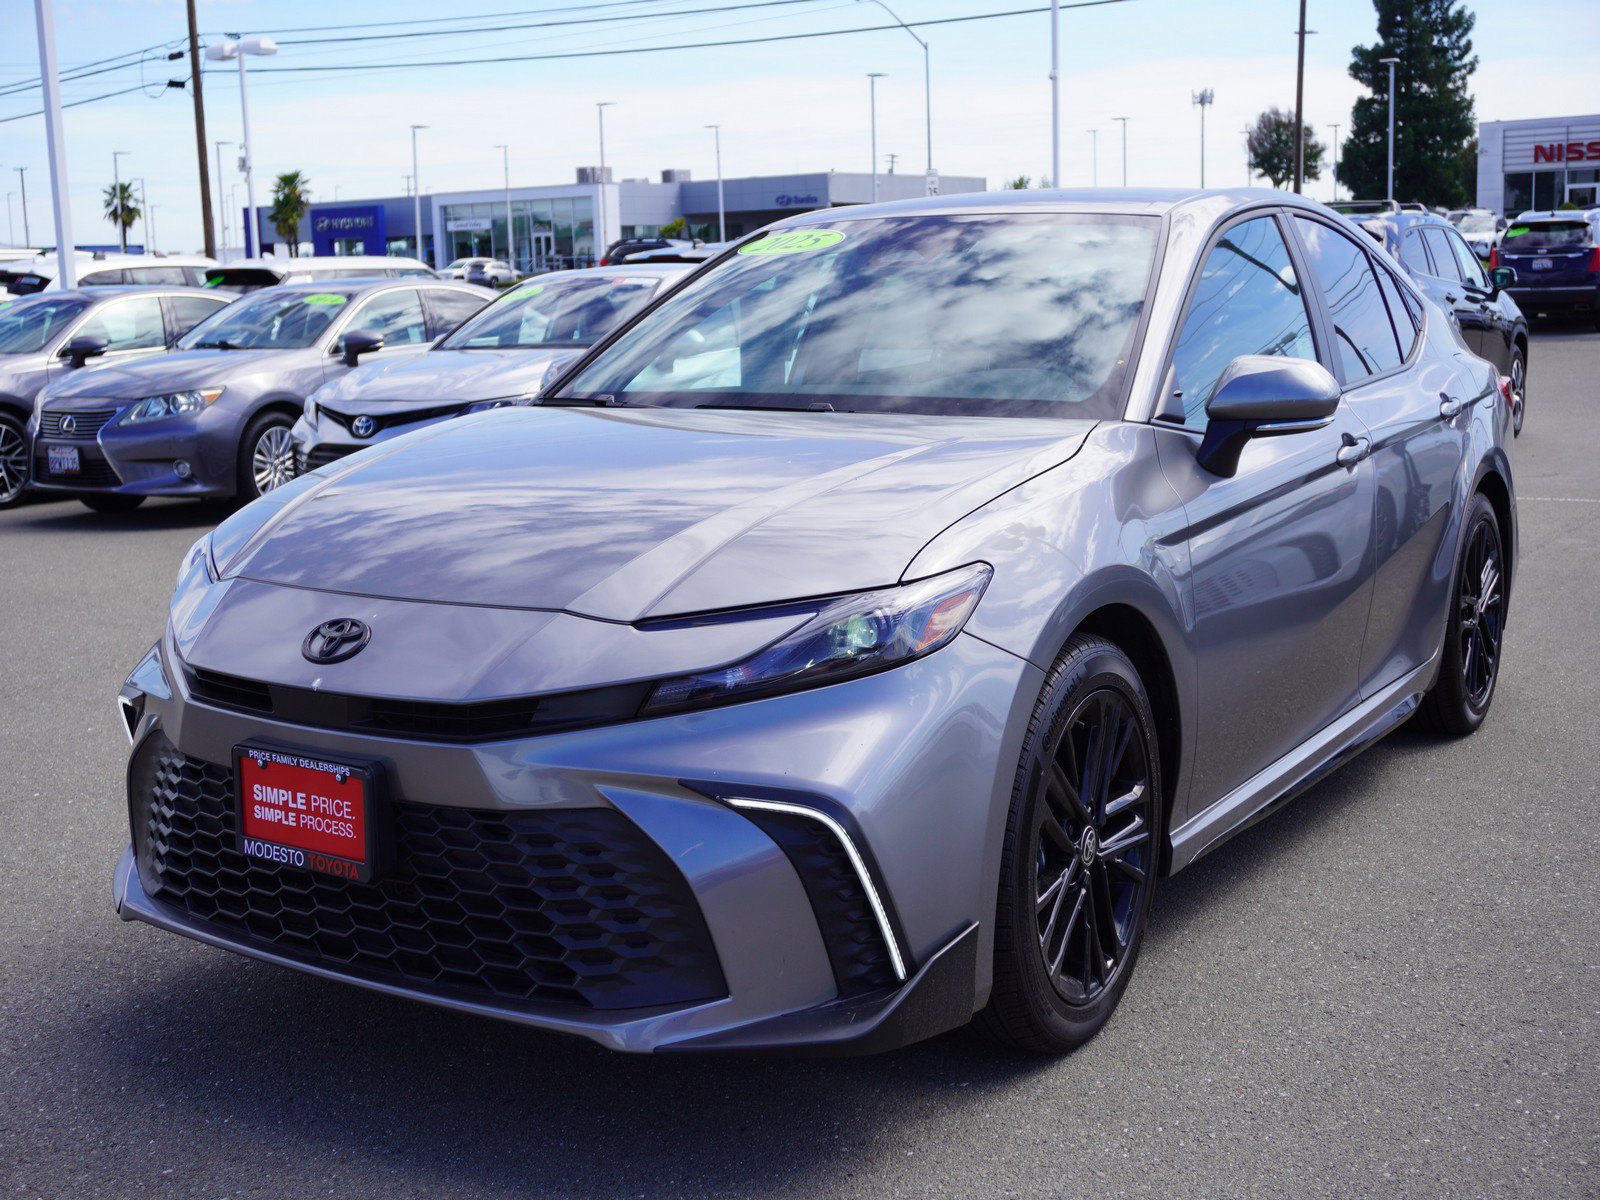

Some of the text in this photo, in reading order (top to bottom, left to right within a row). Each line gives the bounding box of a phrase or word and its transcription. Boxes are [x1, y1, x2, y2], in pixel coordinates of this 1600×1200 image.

[1534, 141, 1600, 163] NISS
[751, 233, 834, 252] 2025
[249, 750, 350, 776] PRICE FAMILY DEALERSHIPS
[253, 784, 356, 820] SIMPLE PRICE.
[254, 805, 357, 839] SIMPLE PROCESS.
[244, 839, 359, 880] MODESTO TOYOTA
